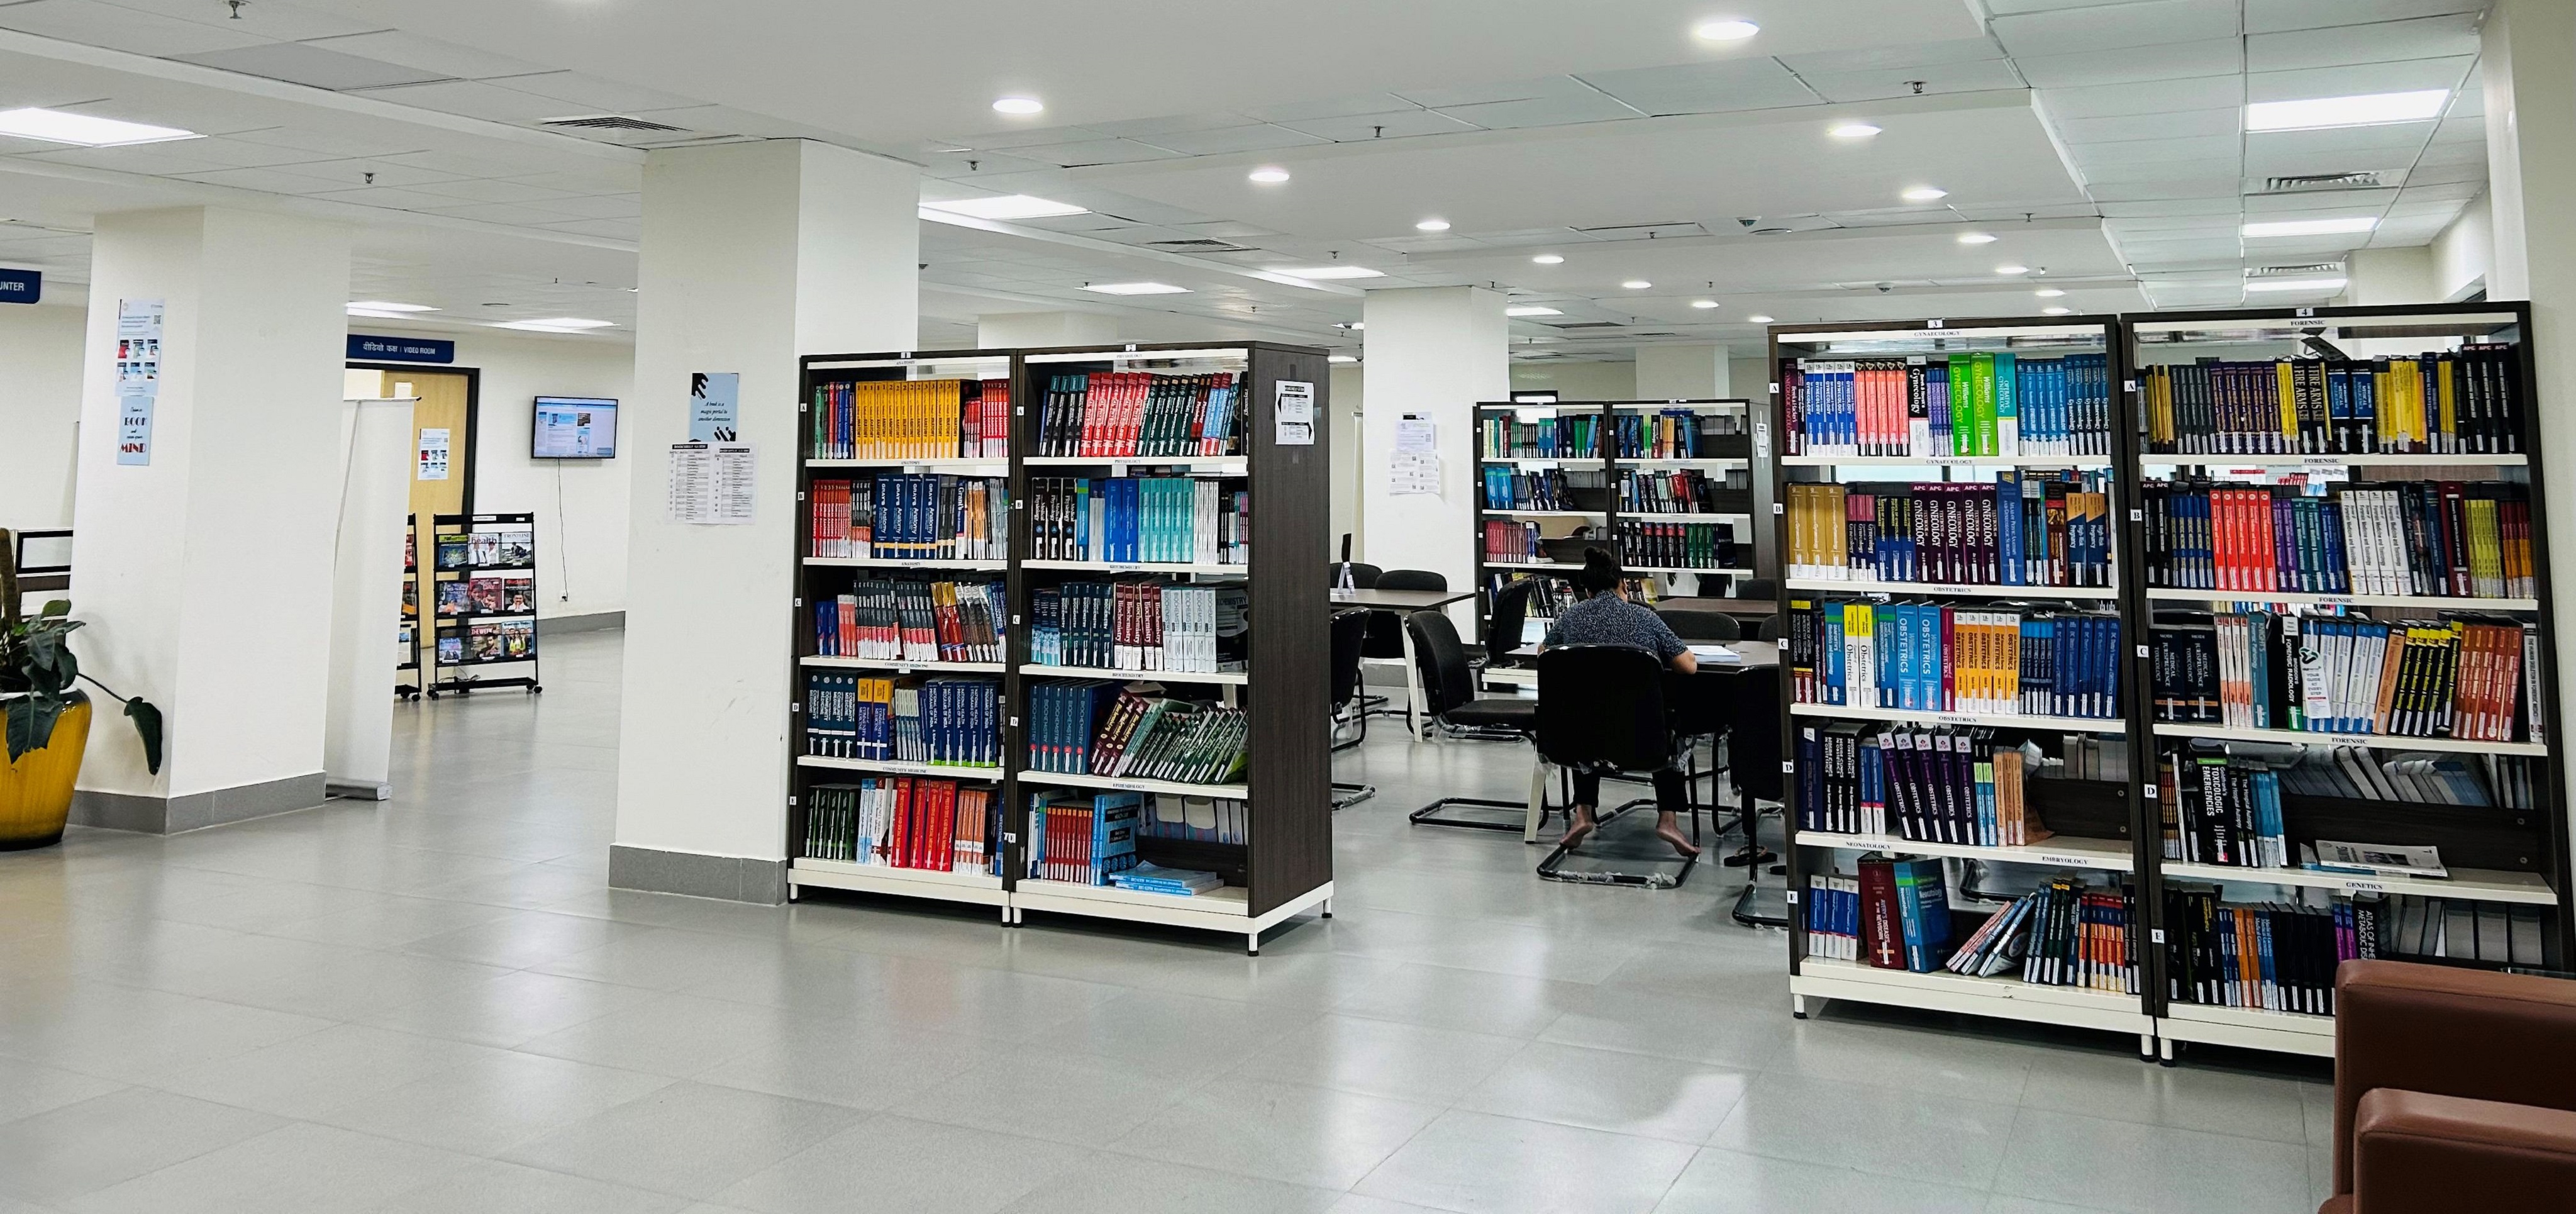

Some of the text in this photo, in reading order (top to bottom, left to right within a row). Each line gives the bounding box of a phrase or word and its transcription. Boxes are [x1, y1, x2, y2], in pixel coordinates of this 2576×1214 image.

[1911, 368, 1921, 415] Gynecology
[1953, 367, 1963, 424] GYNECOLOGY
[1973, 362, 1985, 419] GYNECOLOGY
[120, 443, 147, 453] MIND
[471, 535, 497, 543] health
[1914, 499, 1924, 547] GYNECOLOGY
[1929, 500, 1941, 547] GYNECOLOGY
[1946, 501, 1958, 549] GYNECOLOGY
[1965, 499, 1975, 547] GYNECOLOGY
[1982, 499, 1993, 547] GYNECOLOGY
[1899, 618, 1908, 673] OBSTETRICS
[1921, 619, 1931, 675] OBSTETRICS
[2202, 766, 2215, 816] EMERGENCIES
[2211, 767, 2224, 813] TOXICOLOGIC
[1846, 841, 1891, 850] NEONATOLOGY
[2042, 855, 2089, 866] EMBRYOLOGY
[1900, 888, 1908, 918] Neonatology
[2346, 882, 2383, 890] GENETICS
[2155, 932, 2162, 940] E
